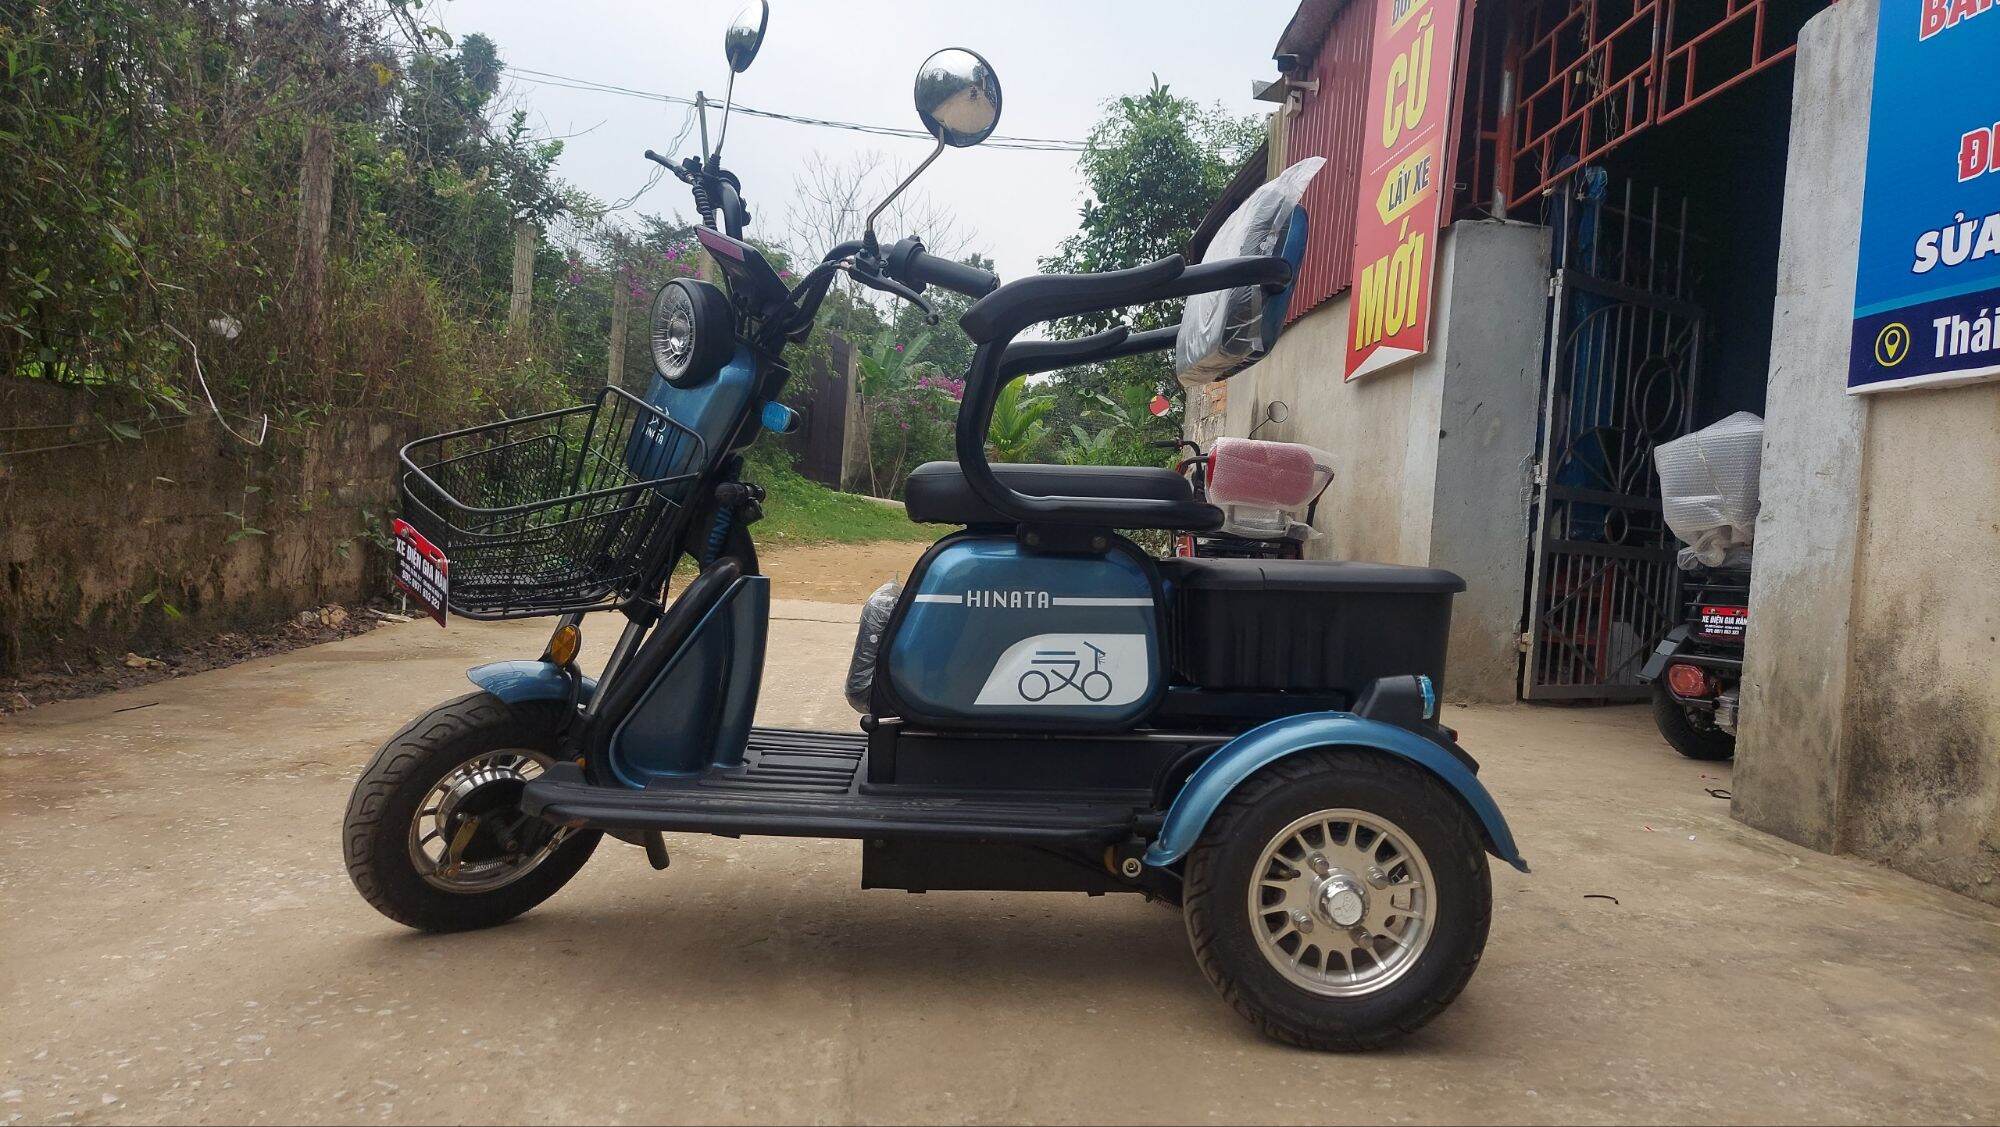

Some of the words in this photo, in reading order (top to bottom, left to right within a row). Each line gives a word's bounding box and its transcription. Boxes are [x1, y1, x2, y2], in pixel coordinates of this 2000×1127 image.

[1383, 7, 1434, 148] CŨ
[1388, 164, 1411, 212] LẤY
[1413, 155, 1431, 194] XE
[1355, 215, 1425, 351] MỚI
[396, 536, 406, 557] XE
[422, 558, 434, 582] GIA
[966, 590, 1049, 609] HINATA
[1701, 615, 1710, 623] XE
